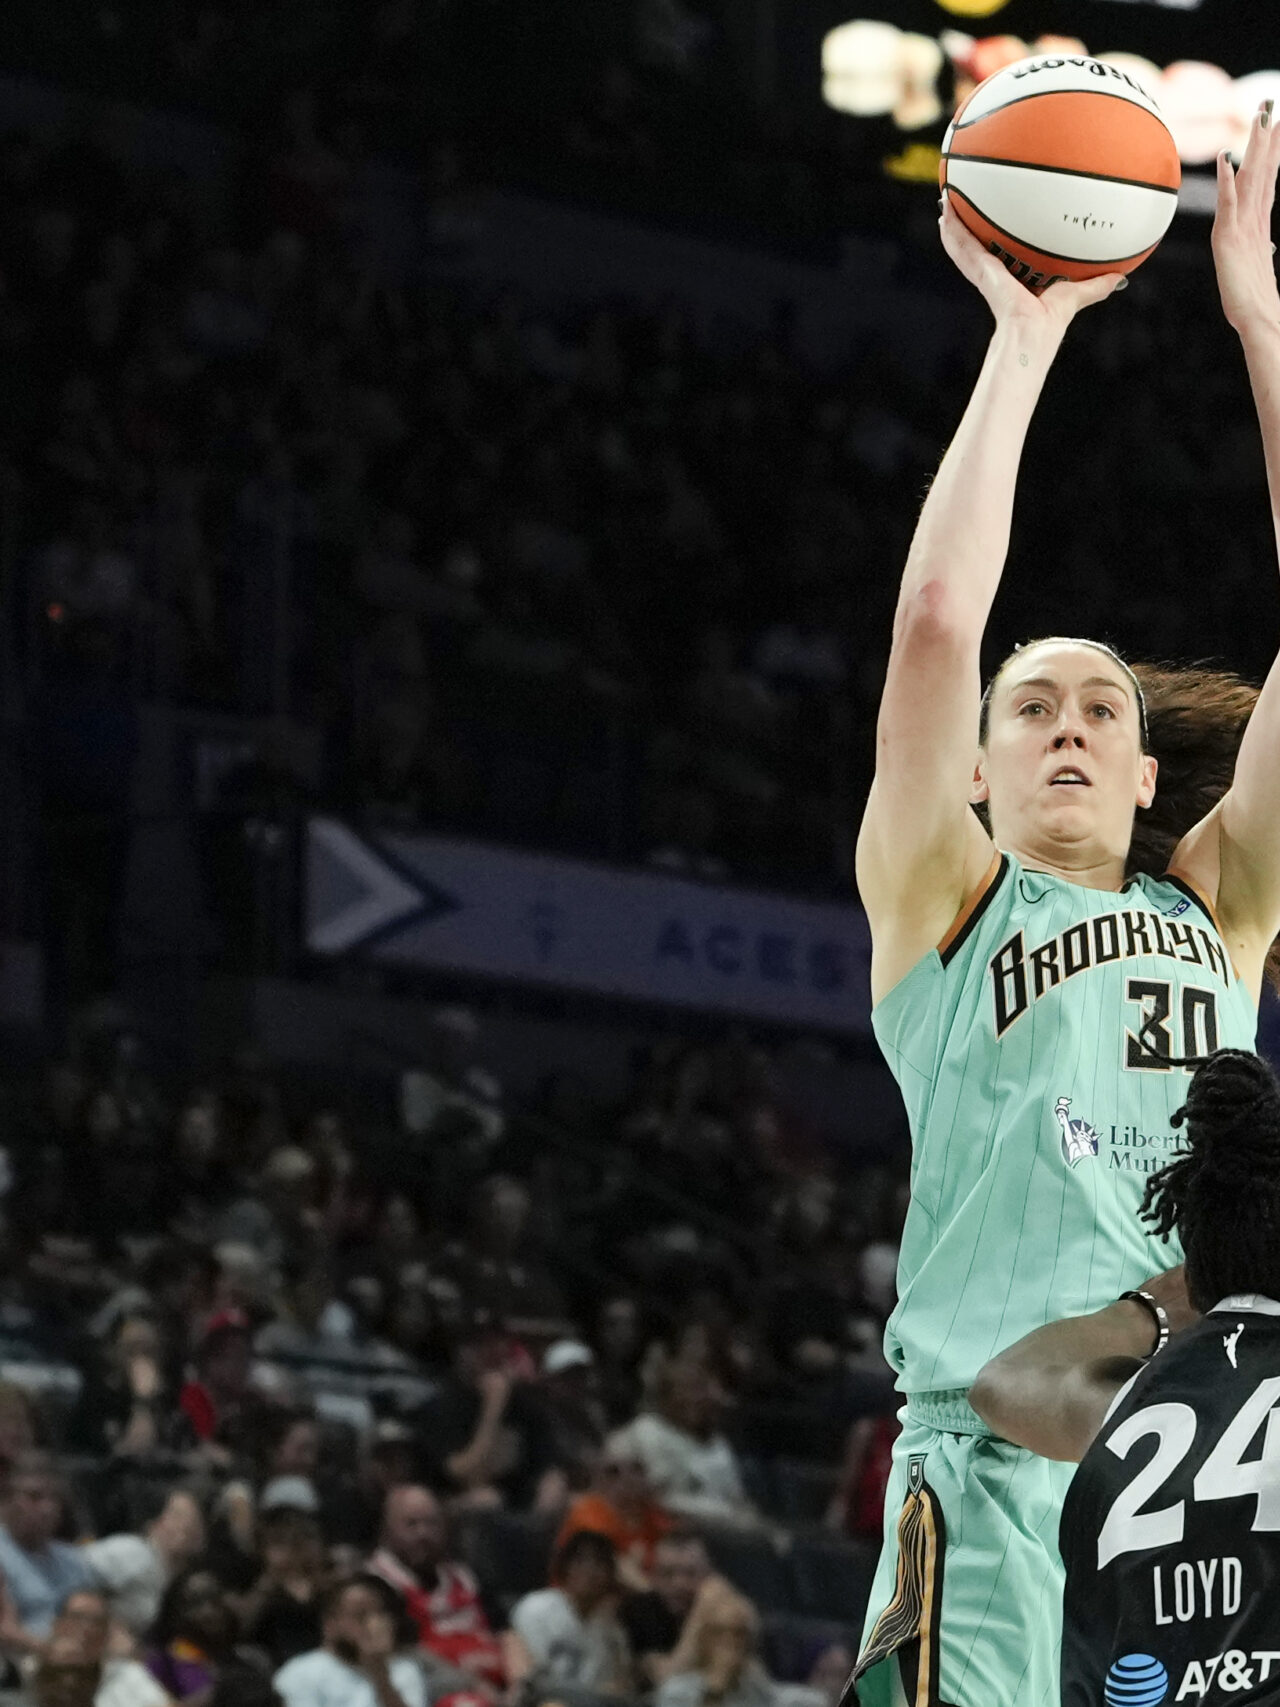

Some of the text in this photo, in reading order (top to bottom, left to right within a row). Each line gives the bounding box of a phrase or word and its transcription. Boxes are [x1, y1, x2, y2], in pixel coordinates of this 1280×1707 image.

[655, 920, 870, 990] ACES
[1123, 976, 1220, 1076] 30
[1153, 1556, 1242, 1625] LOYD
